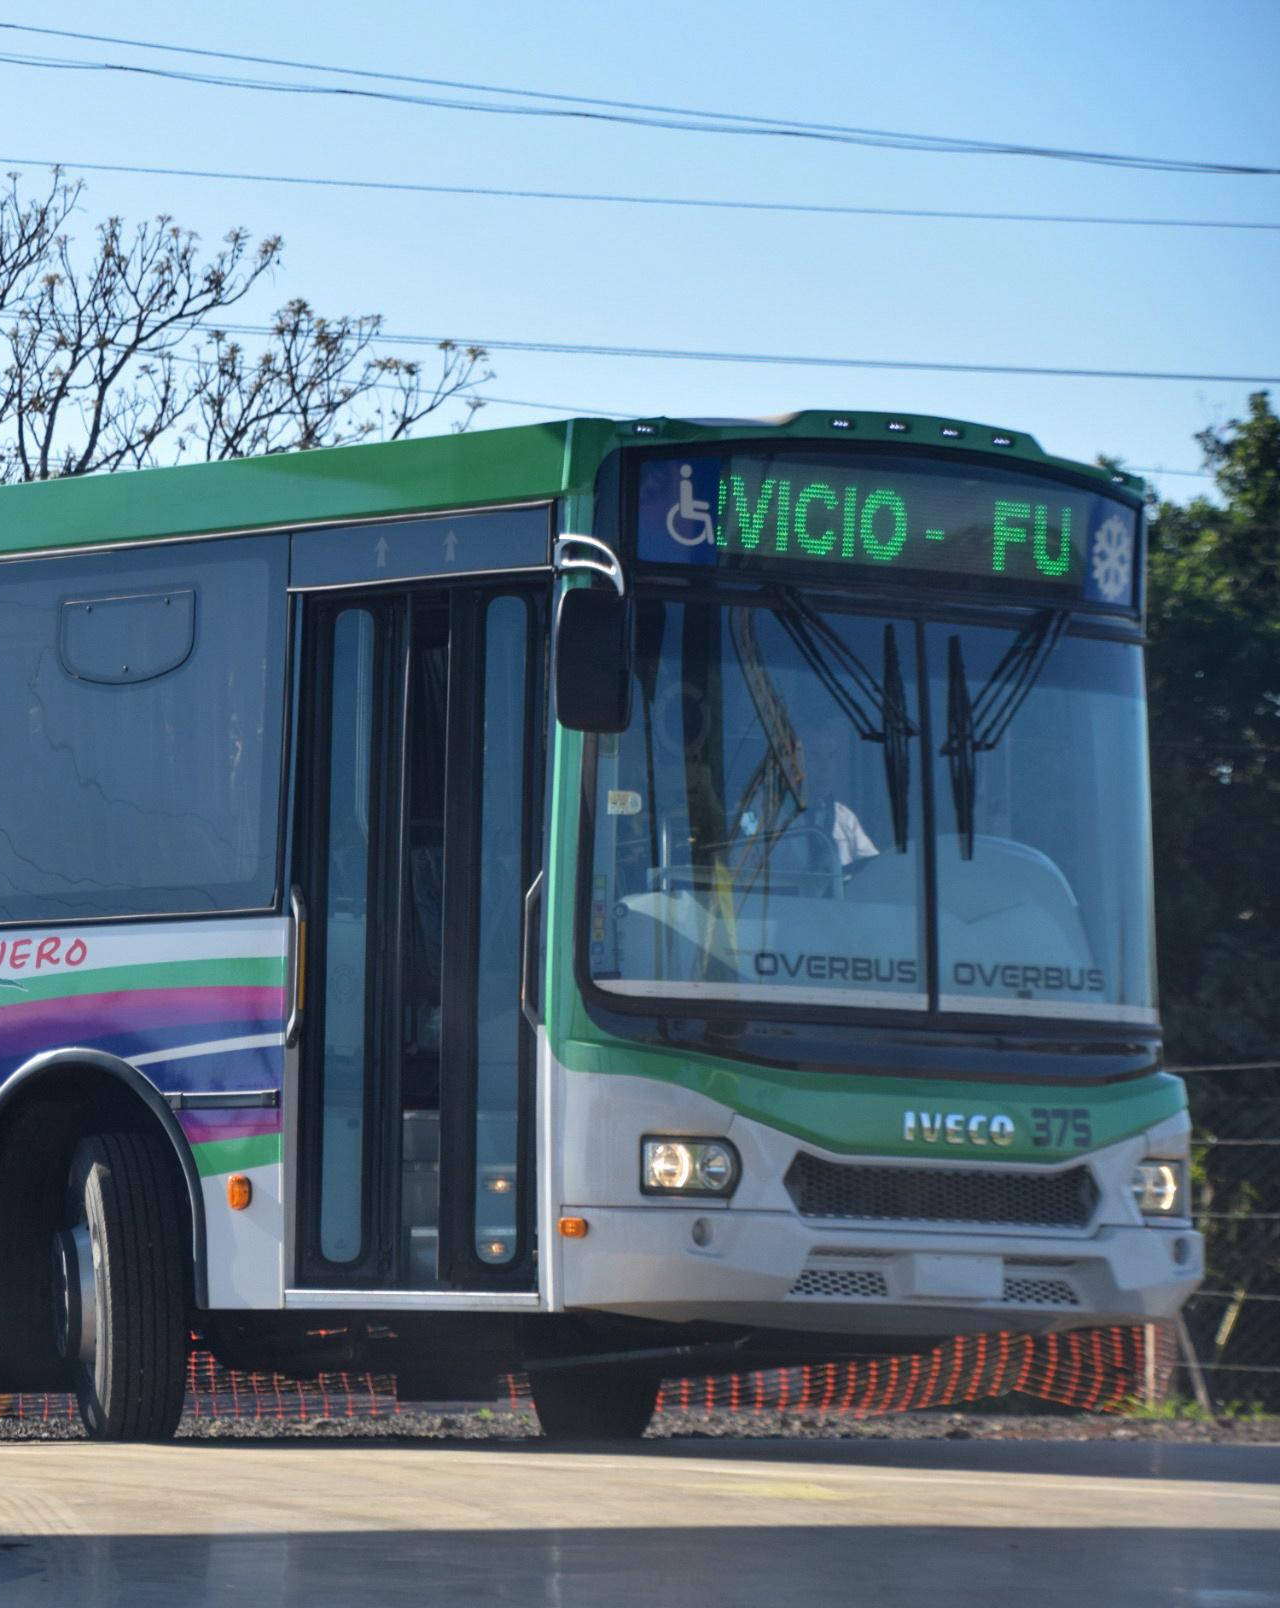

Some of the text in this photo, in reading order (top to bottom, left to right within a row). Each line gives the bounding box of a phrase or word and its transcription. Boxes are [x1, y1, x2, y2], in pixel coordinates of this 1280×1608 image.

[992, 500, 1071, 576] FU
[754, 951, 918, 984] OVERBUS
[953, 961, 1106, 992] OVERBUS
[903, 1110, 1015, 1146] IVECO
[1031, 1108, 1092, 1148] 375
